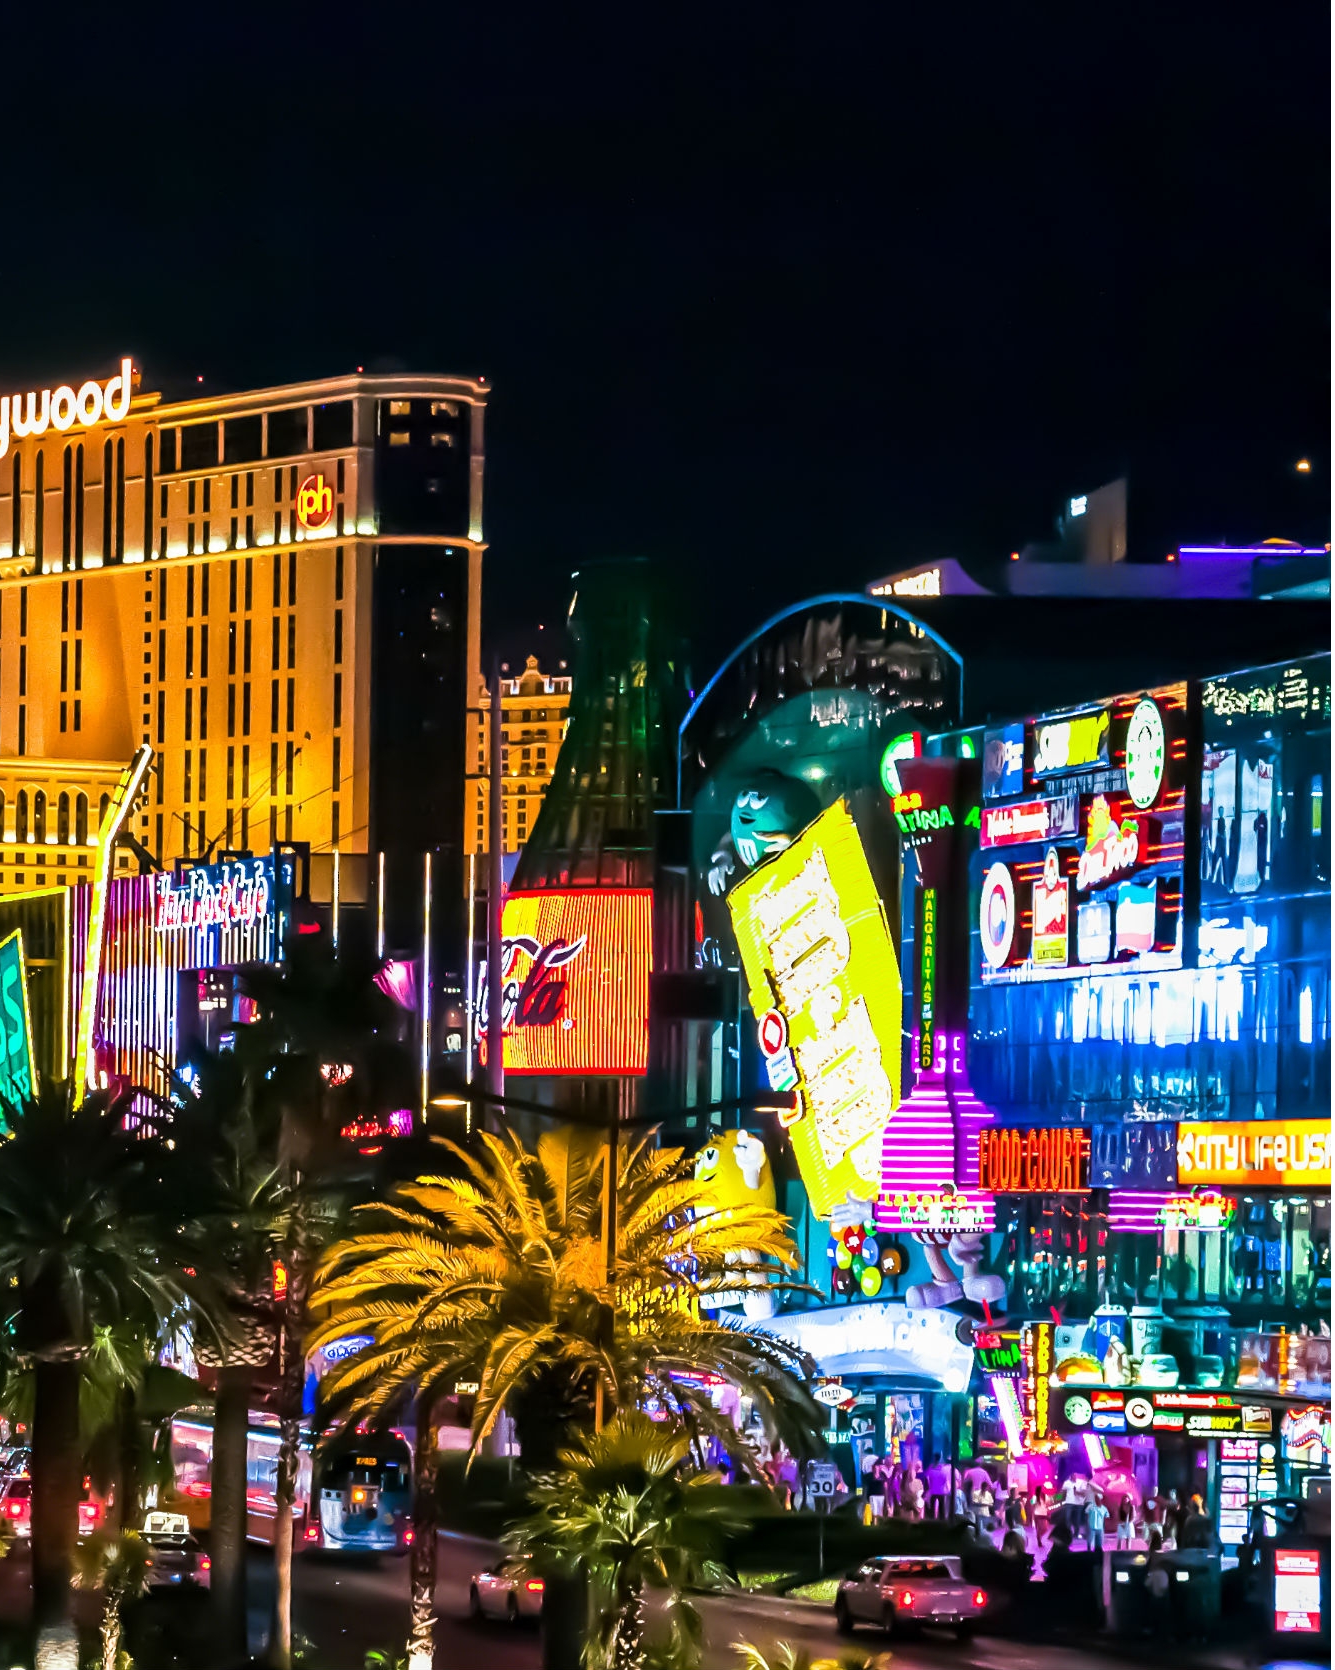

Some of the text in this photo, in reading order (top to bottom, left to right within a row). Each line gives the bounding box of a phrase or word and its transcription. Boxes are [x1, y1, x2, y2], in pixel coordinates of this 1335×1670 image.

[923, 889, 935, 1003] MARGARITAS
[922, 1021, 931, 1067] YARD
[979, 1127, 1084, 1190] FOOD COURT
[1186, 1415, 1241, 1430] SUBWAY
[812, 1481, 833, 1494] 30
